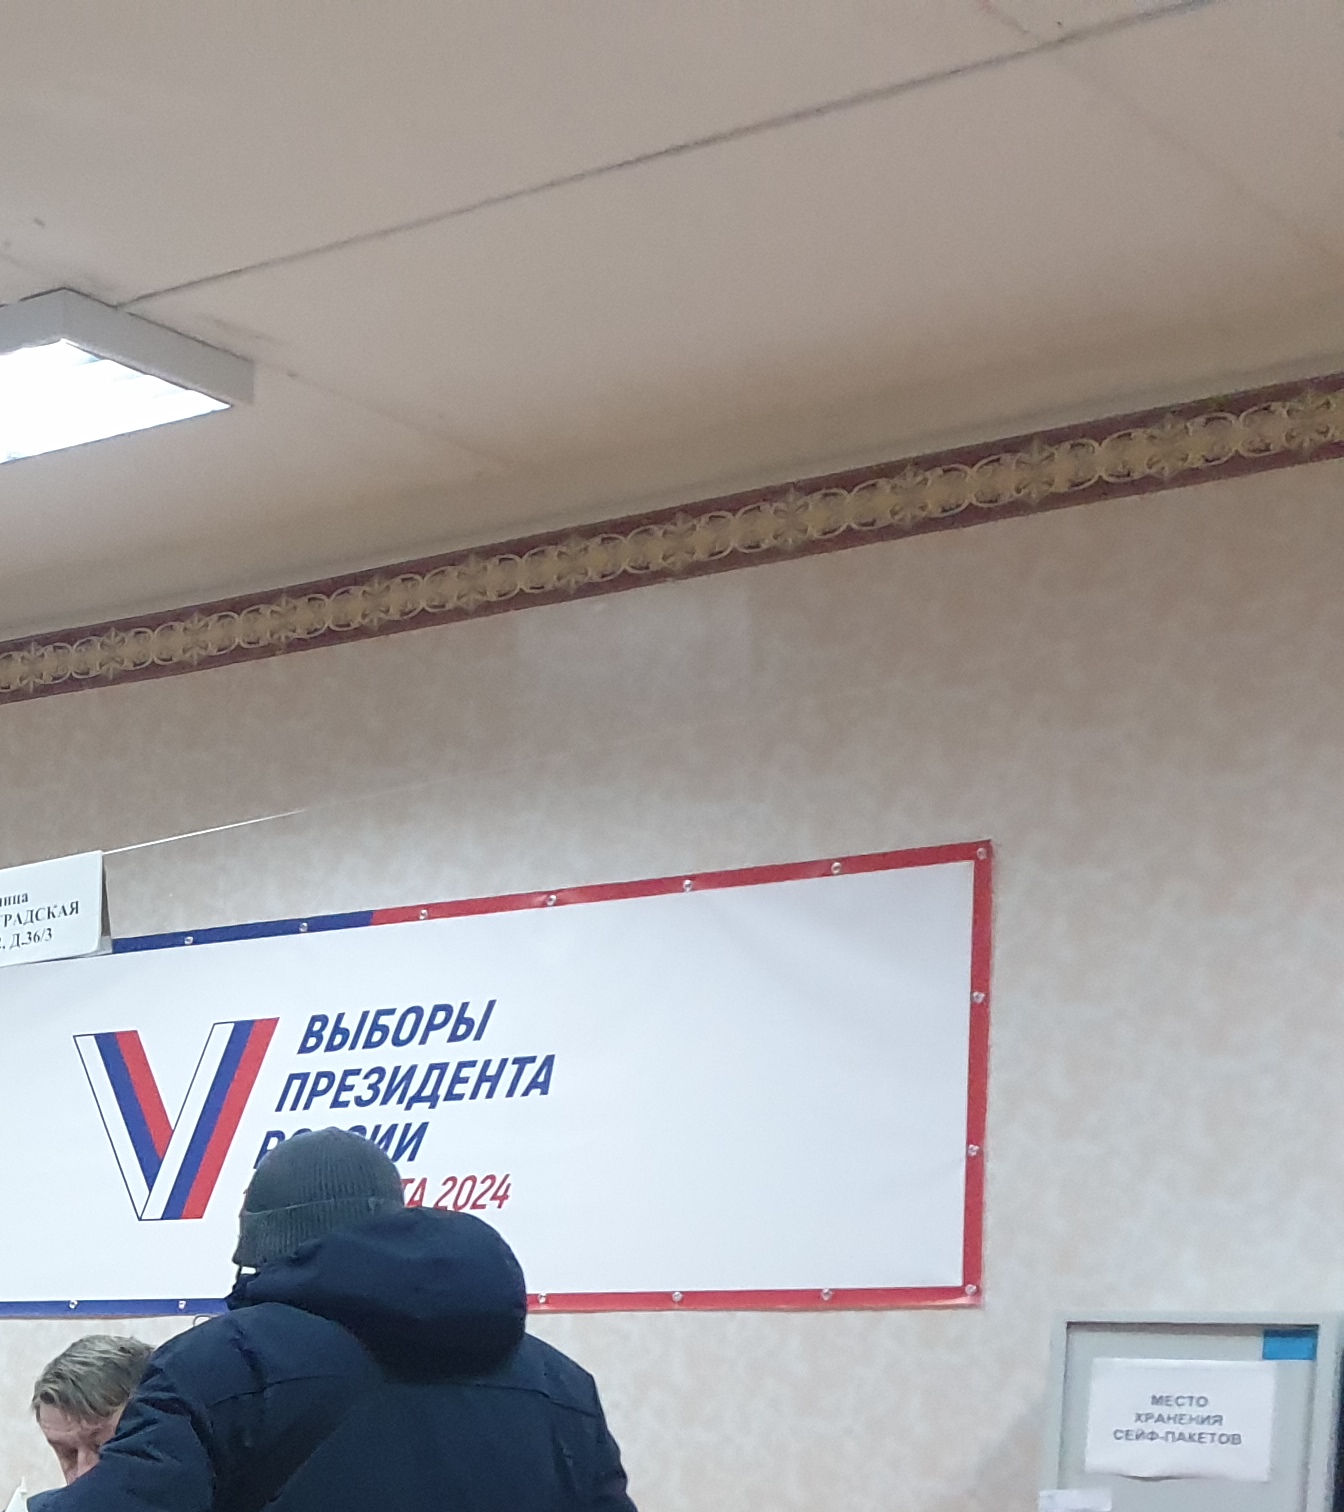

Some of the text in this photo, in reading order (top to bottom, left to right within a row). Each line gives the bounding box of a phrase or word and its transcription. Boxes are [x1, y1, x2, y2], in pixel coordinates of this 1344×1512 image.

[297, 999, 497, 1055] ВЫБОРЫ
[274, 1054, 556, 1113] ПРЕЗИДЕНТА
[1150, 1394, 1209, 1408] МЕСТО
[1134, 1412, 1224, 1427] ХРАНЕНИЯ
[1113, 1428, 1243, 1446] СЕЙФ-ПАКЕТОВ
